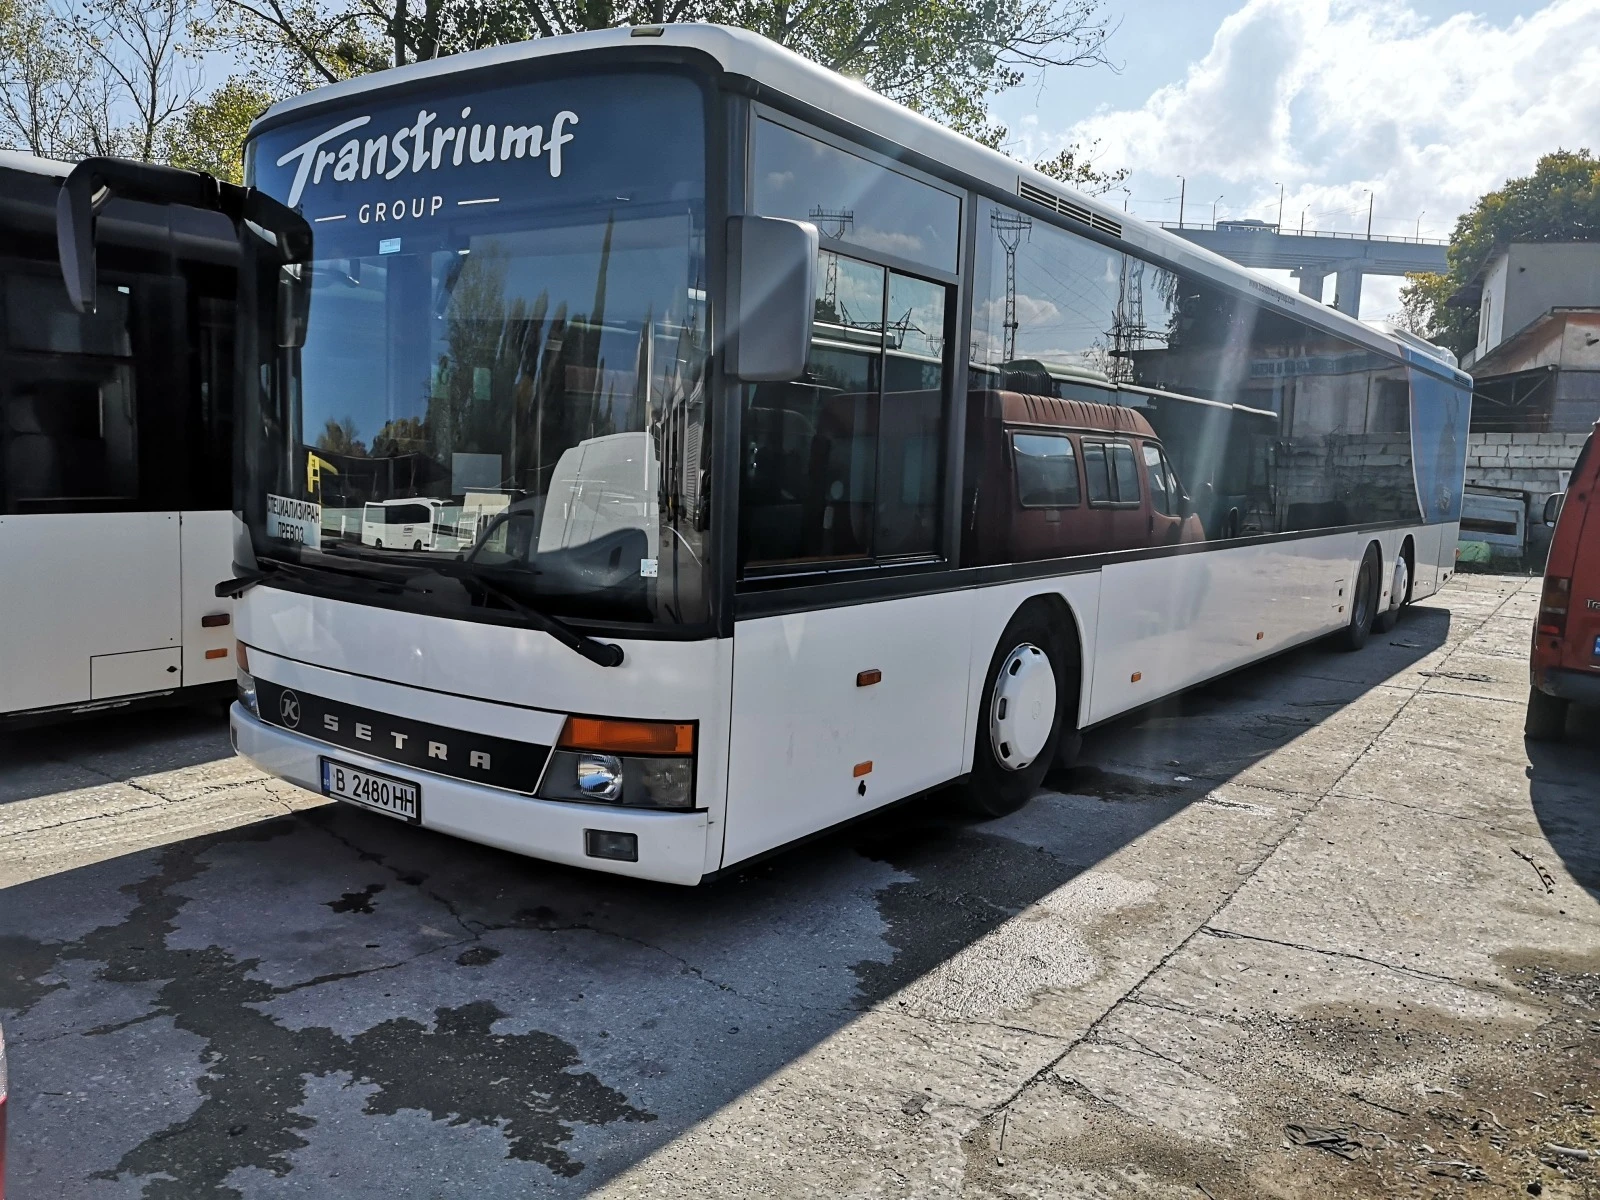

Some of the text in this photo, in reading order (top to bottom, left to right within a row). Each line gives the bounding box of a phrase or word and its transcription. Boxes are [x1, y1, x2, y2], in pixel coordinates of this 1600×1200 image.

[277, 106, 579, 208] Transtriumf
[358, 196, 443, 224] GROUP
[267, 495, 320, 524] СПЕЦИАЛИЗИРАН
[277, 521, 304, 543] ПРЕВОЗ
[323, 713, 492, 771] SETRA
[336, 768, 415, 814] B 2480 HH
